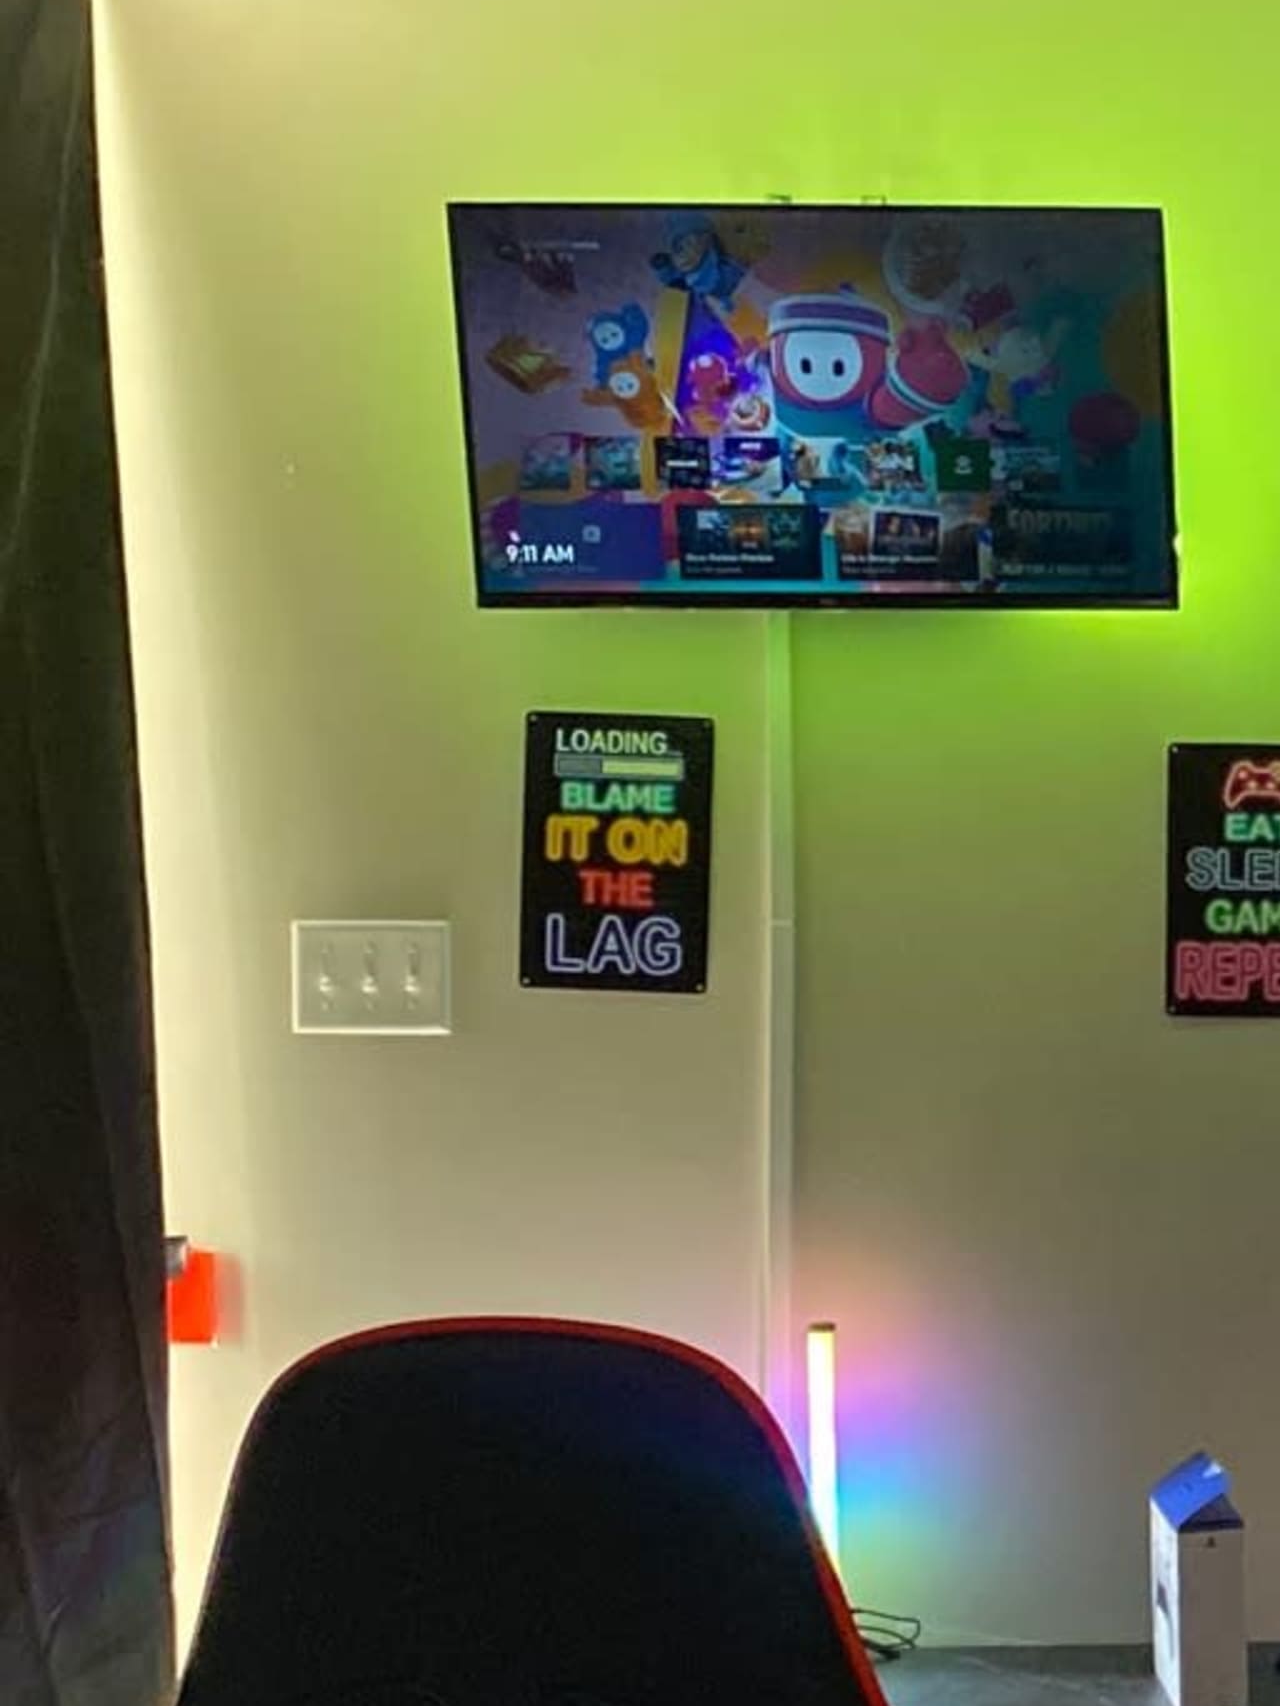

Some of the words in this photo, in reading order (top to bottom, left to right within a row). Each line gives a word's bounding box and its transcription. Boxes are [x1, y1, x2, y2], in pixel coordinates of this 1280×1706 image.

[506, 544, 538, 563] 9:11
[542, 544, 574, 563] AM
[560, 781, 676, 813] BLAME
[545, 813, 600, 861] IT
[606, 817, 689, 867] ON
[579, 869, 654, 907] THE
[545, 912, 682, 976] LAG
